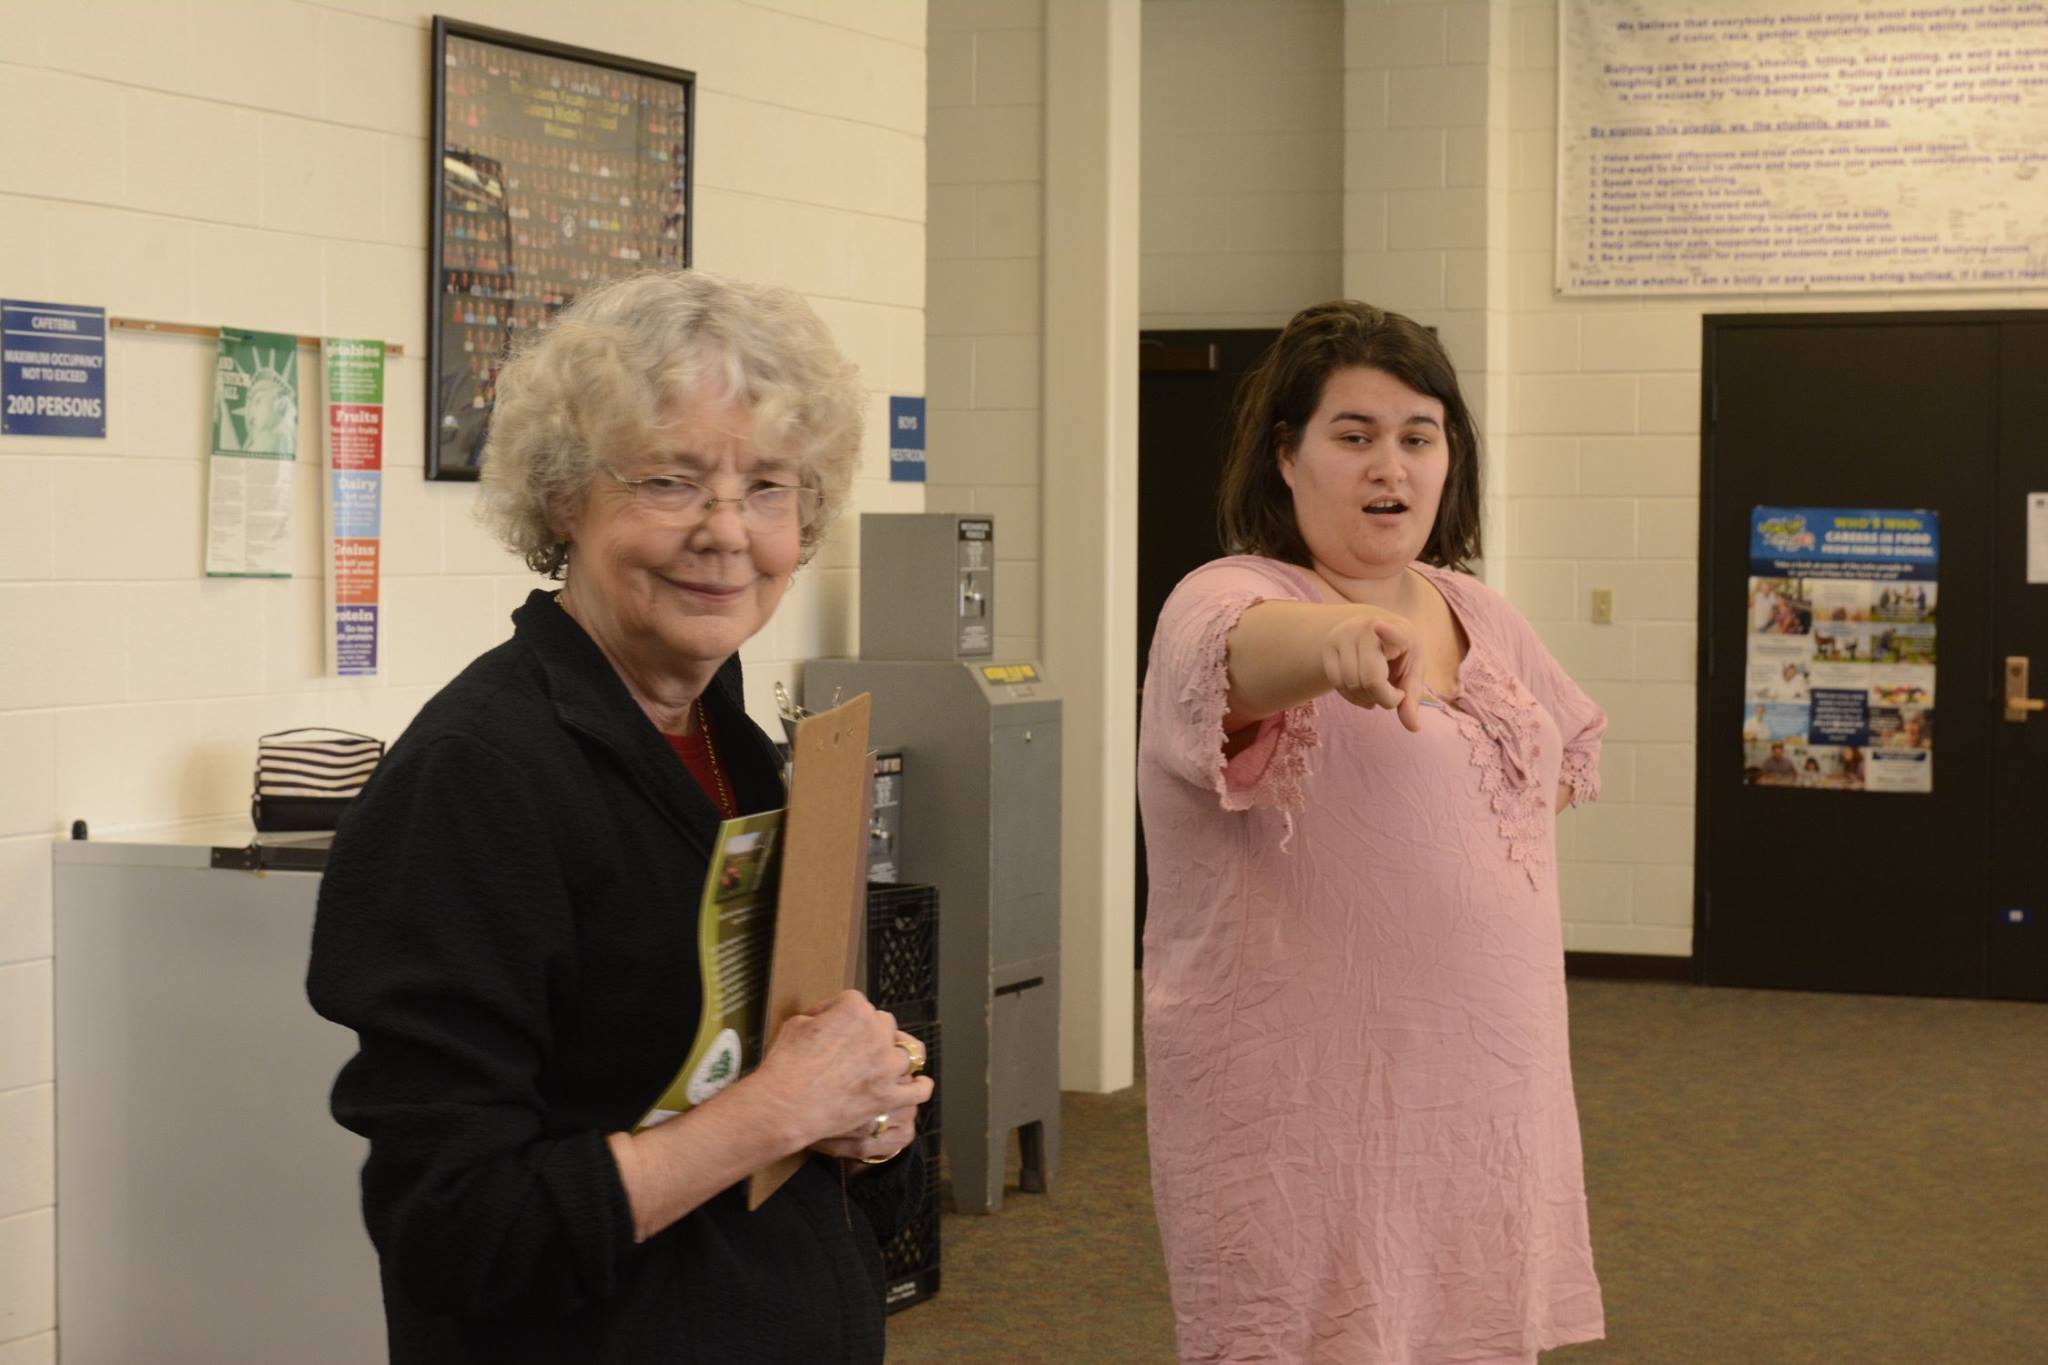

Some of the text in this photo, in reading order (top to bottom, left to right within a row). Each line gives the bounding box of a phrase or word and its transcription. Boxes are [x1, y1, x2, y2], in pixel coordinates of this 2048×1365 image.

[32, 317, 78, 331] CAFETERIA
[4, 350, 103, 368] MAXIMUM OCCUPANCY
[21, 367, 88, 383] NOT TO EXCEED
[7, 395, 102, 418] 200 PERSONS
[336, 411, 379, 424] Fruits
[897, 416, 917, 430] BOYS
[338, 478, 377, 493] Dairy
[1825, 531, 1878, 543] CAREERS
[1894, 532, 1931, 545] FOOD
[1821, 543, 1851, 554] FROM
[1852, 544, 1878, 555] FARM
[1893, 545, 1935, 557] SCHOOL
